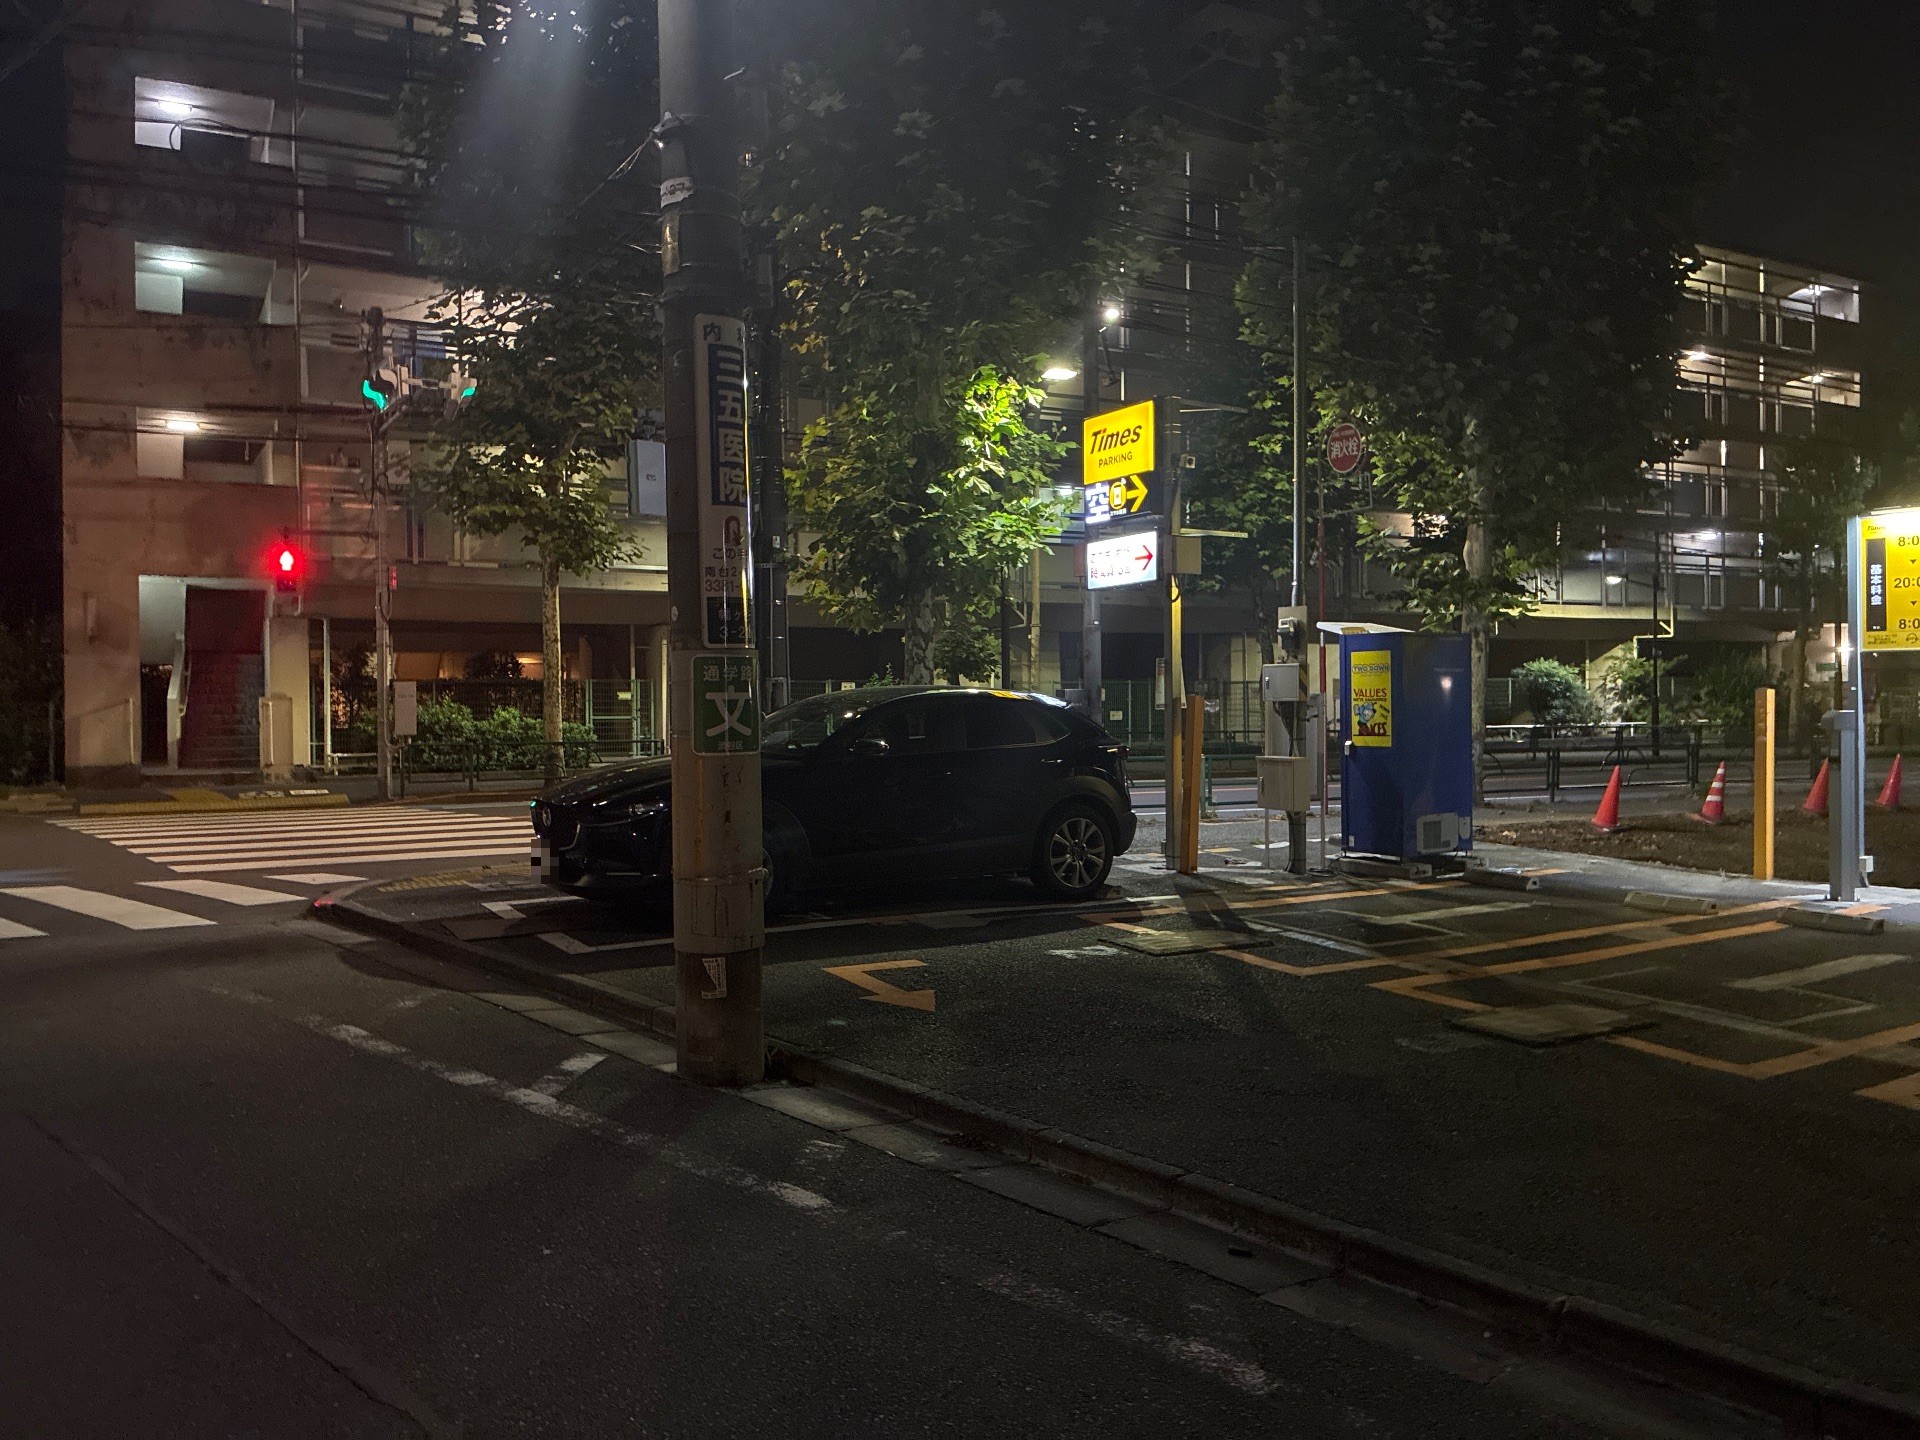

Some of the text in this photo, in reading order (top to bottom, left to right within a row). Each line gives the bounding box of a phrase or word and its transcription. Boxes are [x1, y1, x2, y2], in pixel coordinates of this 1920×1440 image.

[1089, 423, 1143, 455] Times
[1330, 437, 1358, 459] 消火栓
[1098, 451, 1133, 469] PARKING
[1085, 482, 1111, 525] 空
[703, 665, 753, 682] 通学路
[1353, 688, 1387, 698] VALUES
